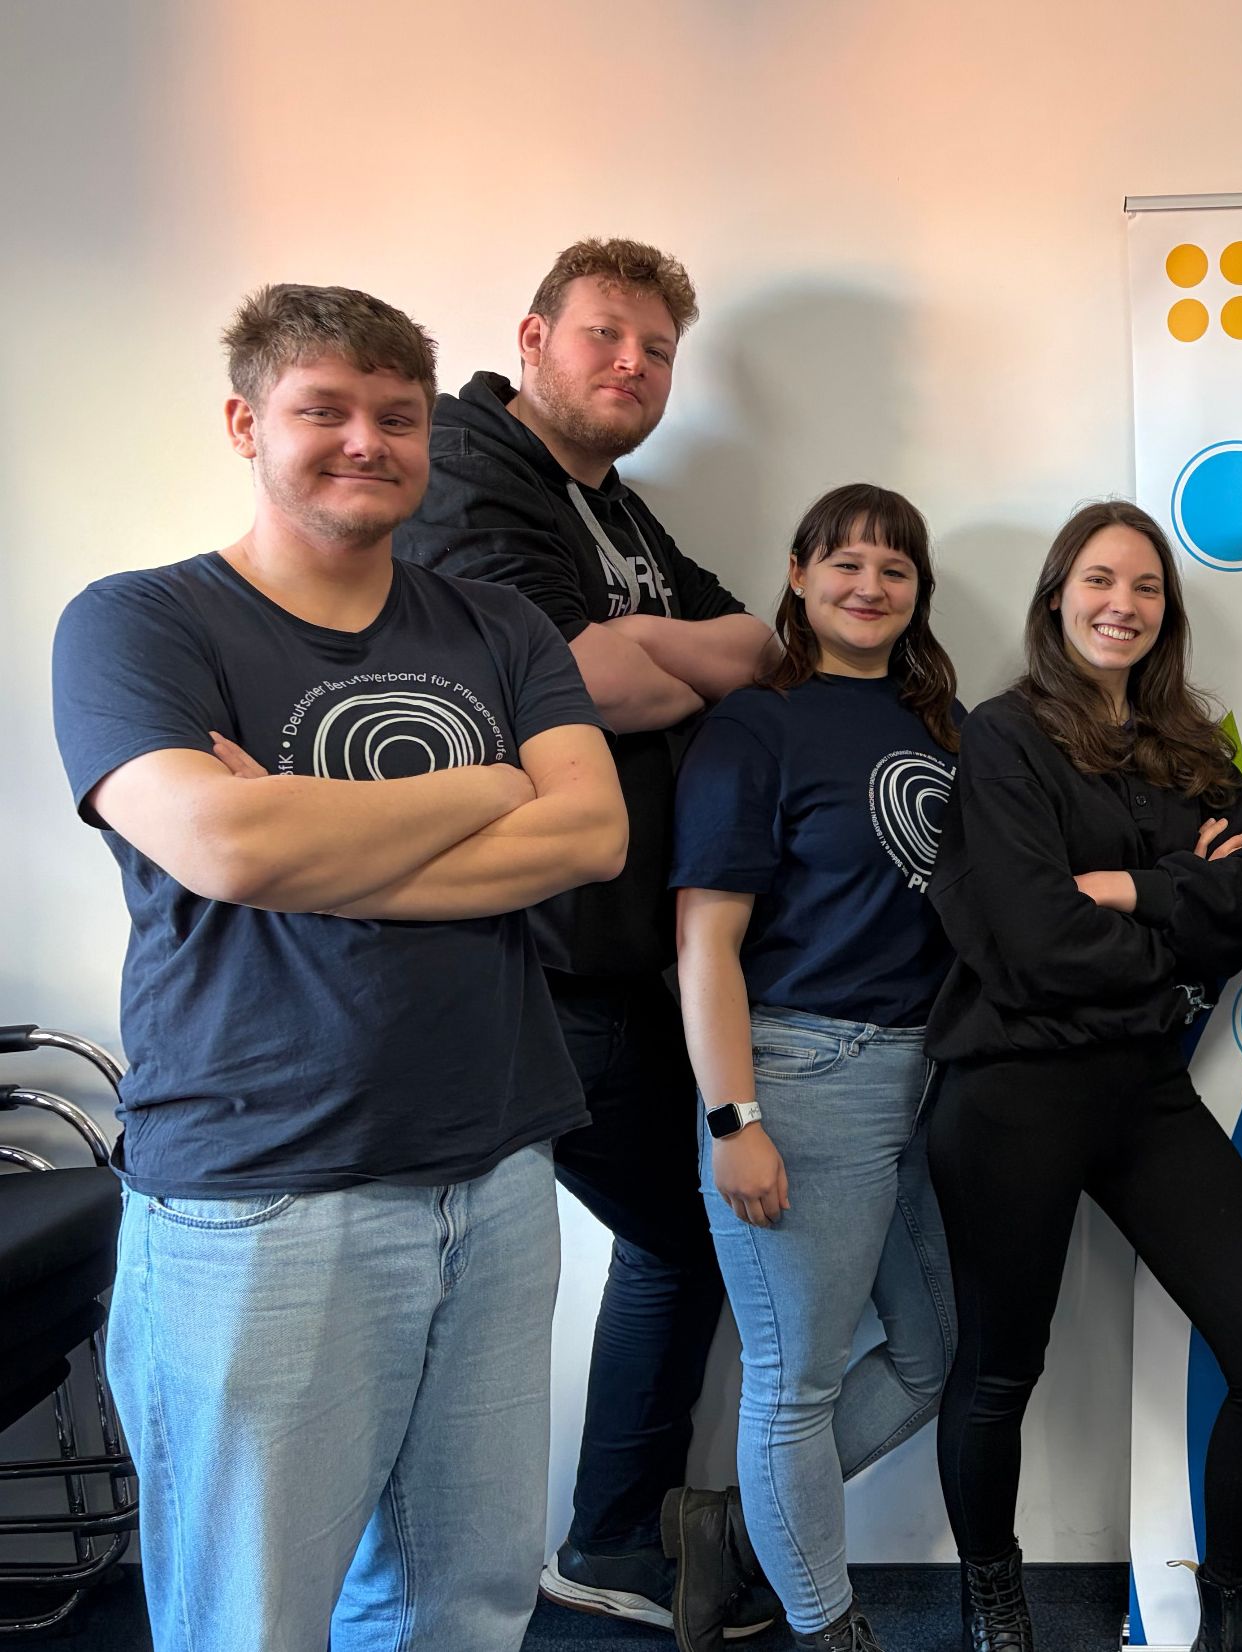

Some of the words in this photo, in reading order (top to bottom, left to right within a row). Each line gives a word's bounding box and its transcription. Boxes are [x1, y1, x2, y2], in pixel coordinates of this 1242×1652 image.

[282, 685, 326, 736] Deutscher
[323, 672, 427, 692] Berufsverband
[431, 674, 451, 688] für
[453, 683, 507, 761] Pflegeberufe
